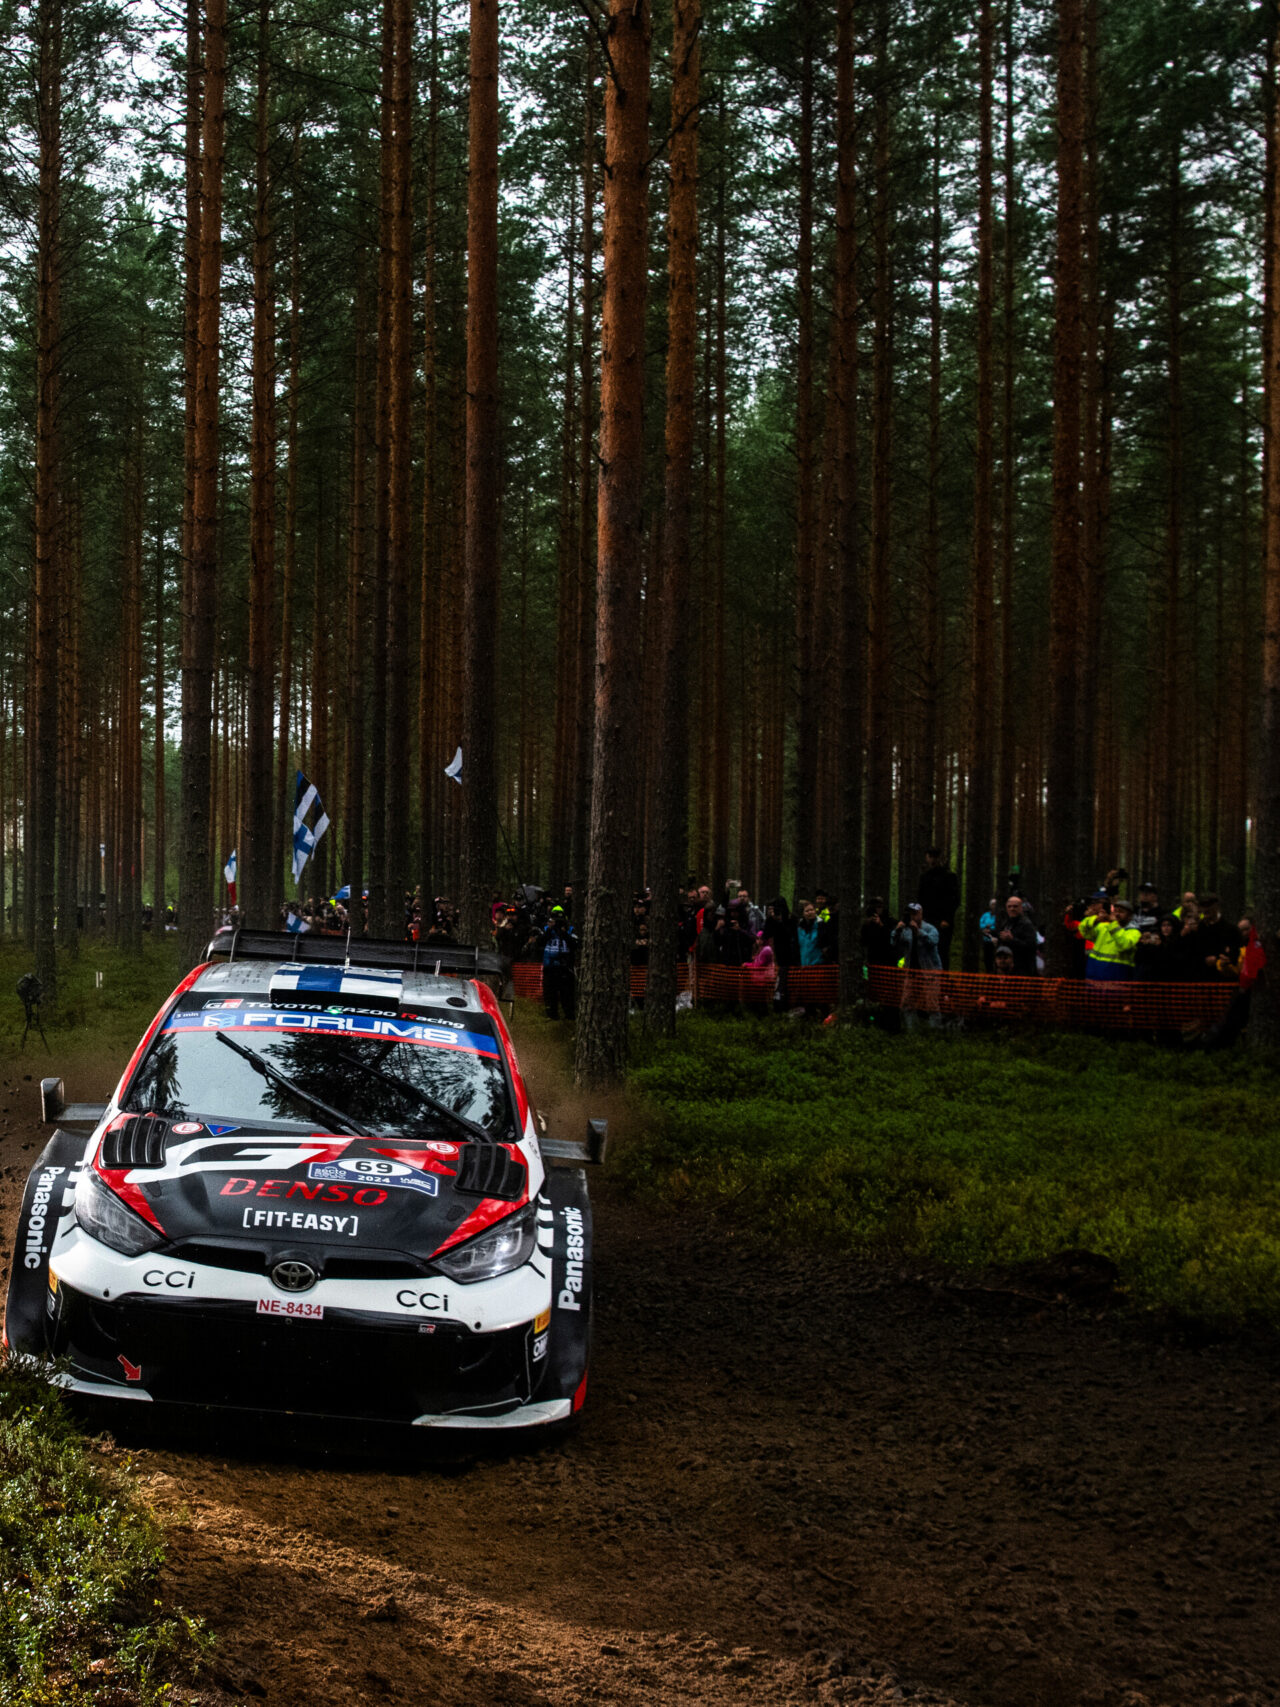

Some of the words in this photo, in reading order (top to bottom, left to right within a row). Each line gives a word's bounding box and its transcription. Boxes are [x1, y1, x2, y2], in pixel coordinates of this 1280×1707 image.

[246, 1001, 322, 1010] TOYOTA
[326, 1005, 397, 1017] GAZOO
[401, 1012, 465, 1029] Racing
[243, 1013, 458, 1044] FORUM8
[355, 1160, 393, 1174] 69
[357, 1175, 391, 1184] 2024
[219, 1177, 388, 1206] DENSO
[24, 1166, 66, 1269] Panasonic
[558, 1206, 584, 1311] Panasonic
[142, 1269, 196, 1289] CCi
[258, 1299, 322, 1317] NE-8434
[396, 1289, 449, 1312] CCi
